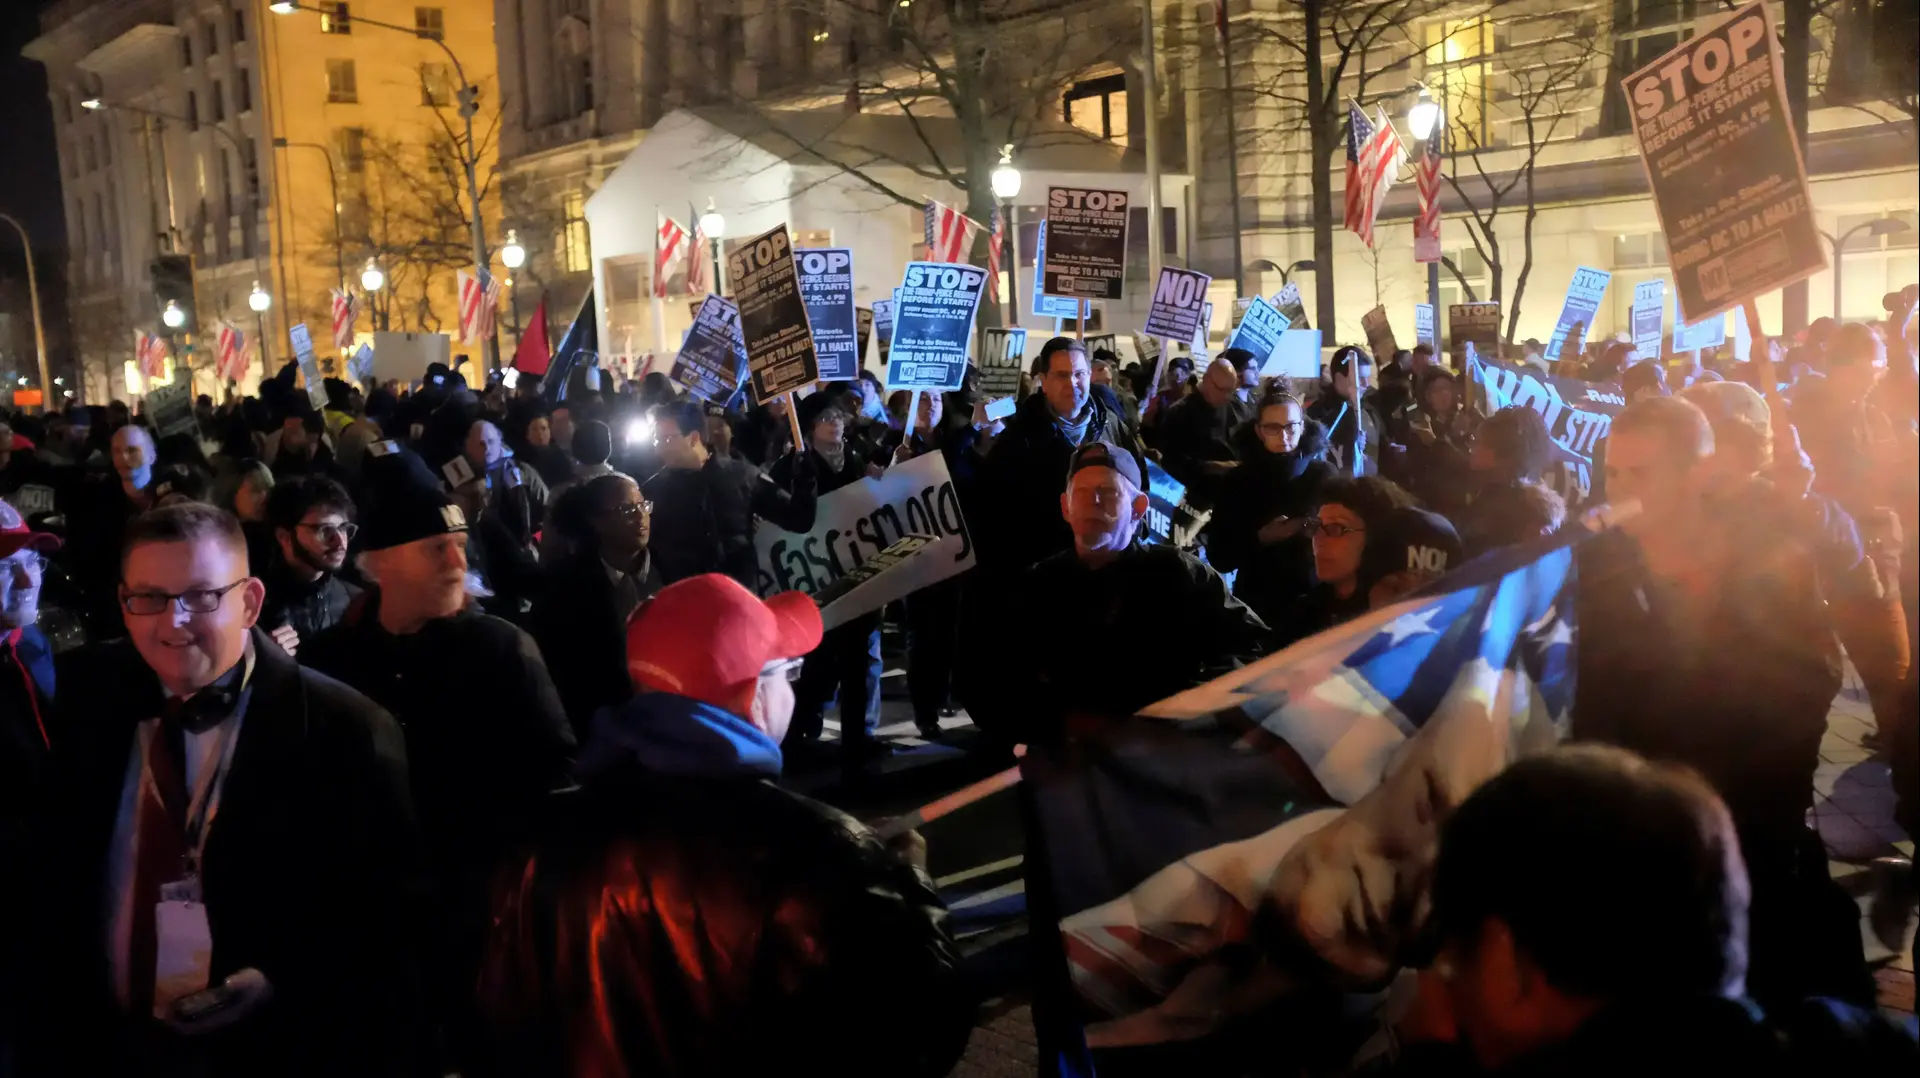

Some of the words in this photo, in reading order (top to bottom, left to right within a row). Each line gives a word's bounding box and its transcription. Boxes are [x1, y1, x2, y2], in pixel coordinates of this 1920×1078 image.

[1634, 16, 1764, 119] STOP
[1644, 116, 1696, 154] BEFORE
[1697, 106, 1711, 124] IT
[1714, 73, 1772, 114] STARTS
[1050, 189, 1126, 211] STOP
[1092, 218, 1124, 226] STARTS
[1730, 220, 1750, 240] TO
[1752, 214, 1763, 232] A
[730, 232, 787, 280] STOP
[906, 266, 981, 290] STOP
[1082, 267, 1092, 276] TO
[813, 282, 850, 290] STARTS
[1156, 271, 1206, 310] NO!
[902, 295, 934, 304] BEFORE
[942, 298, 974, 306] STARTS
[1451, 306, 1496, 316] STOP
[1250, 300, 1286, 334] STOP
[820, 342, 828, 352] A
[828, 342, 854, 352] HALT!
[914, 352, 924, 362] DC
[926, 352, 935, 362] TO
[934, 353, 940, 362] A
[941, 354, 964, 364] HALT!
[986, 332, 1024, 368] NO!
[1408, 545, 1448, 571] NO!
